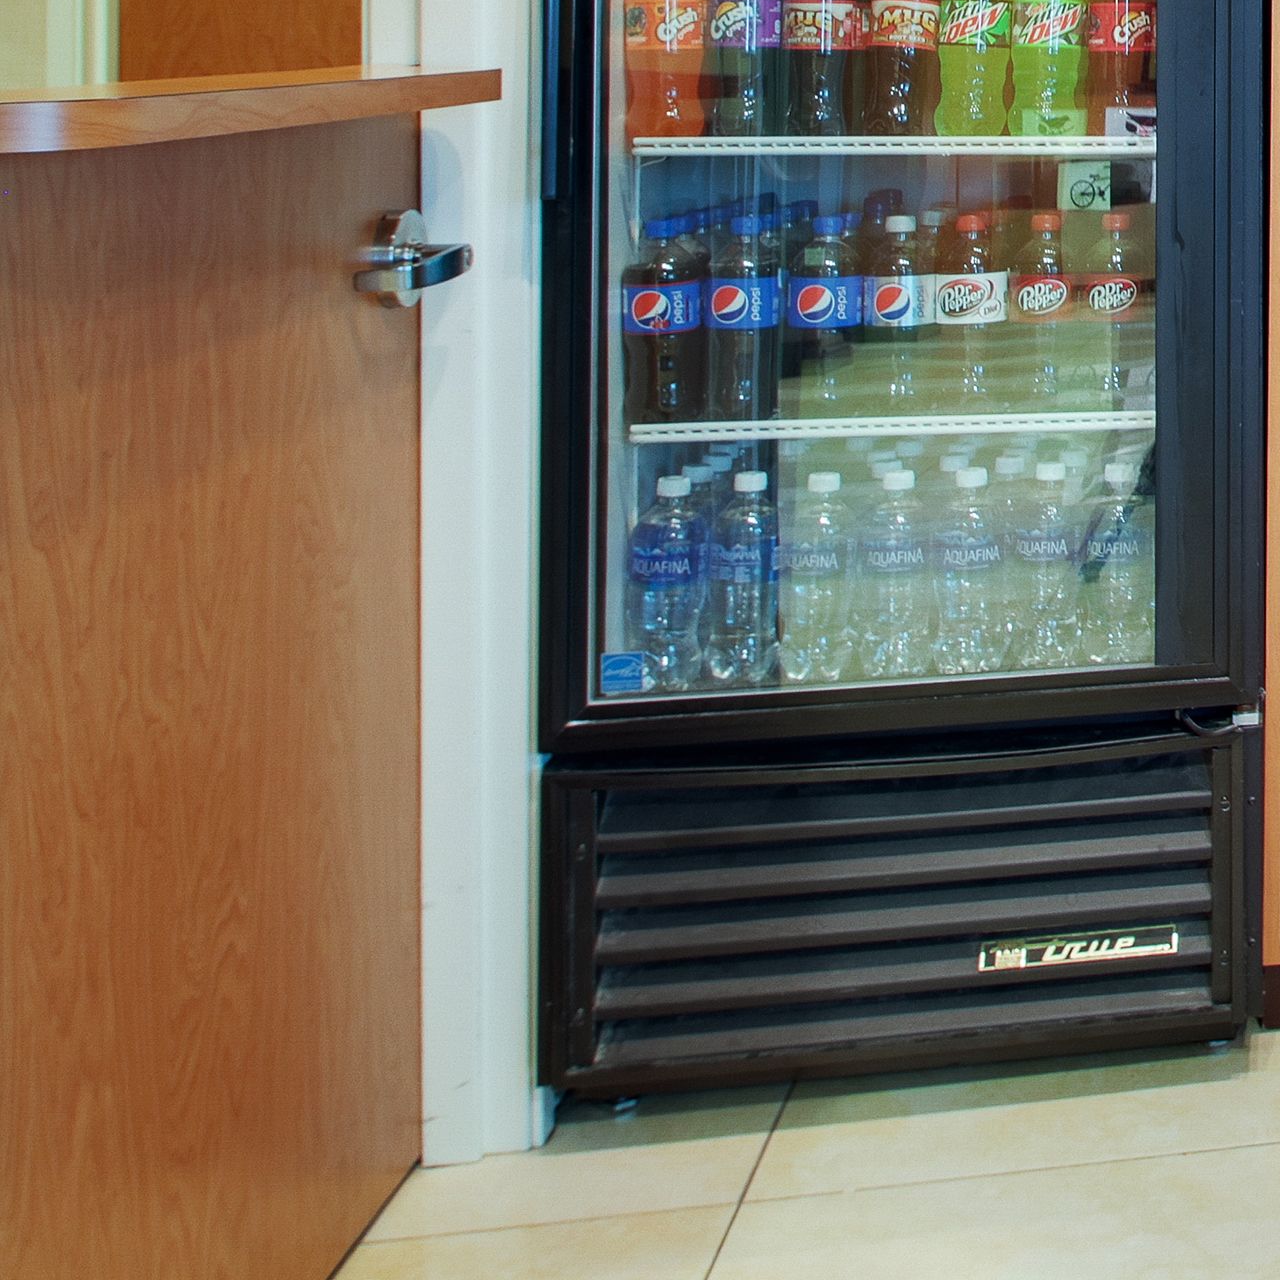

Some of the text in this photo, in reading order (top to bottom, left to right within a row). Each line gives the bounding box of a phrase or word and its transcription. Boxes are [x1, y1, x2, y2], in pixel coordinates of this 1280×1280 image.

[711, 0, 758, 39] Crush
[883, 9, 937, 32] MUG
[1113, 9, 1151, 44] Crush
[941, 291, 986, 313] Pepper
[957, 282, 978, 301] Dr
[1021, 290, 1066, 312] Pepper
[1034, 282, 1053, 301] Dr
[1091, 289, 1135, 312] Pepper
[1105, 282, 1124, 300] Dr
[673, 290, 685, 325] pepsi
[751, 286, 762, 322] pepsi
[837, 286, 848, 321] pepsi
[916, 286, 925, 319] pepsi
[868, 547, 924, 567] AQUAFINA
[943, 545, 1000, 565] AQUAFINA
[1017, 539, 1069, 557] AQUAFINA
